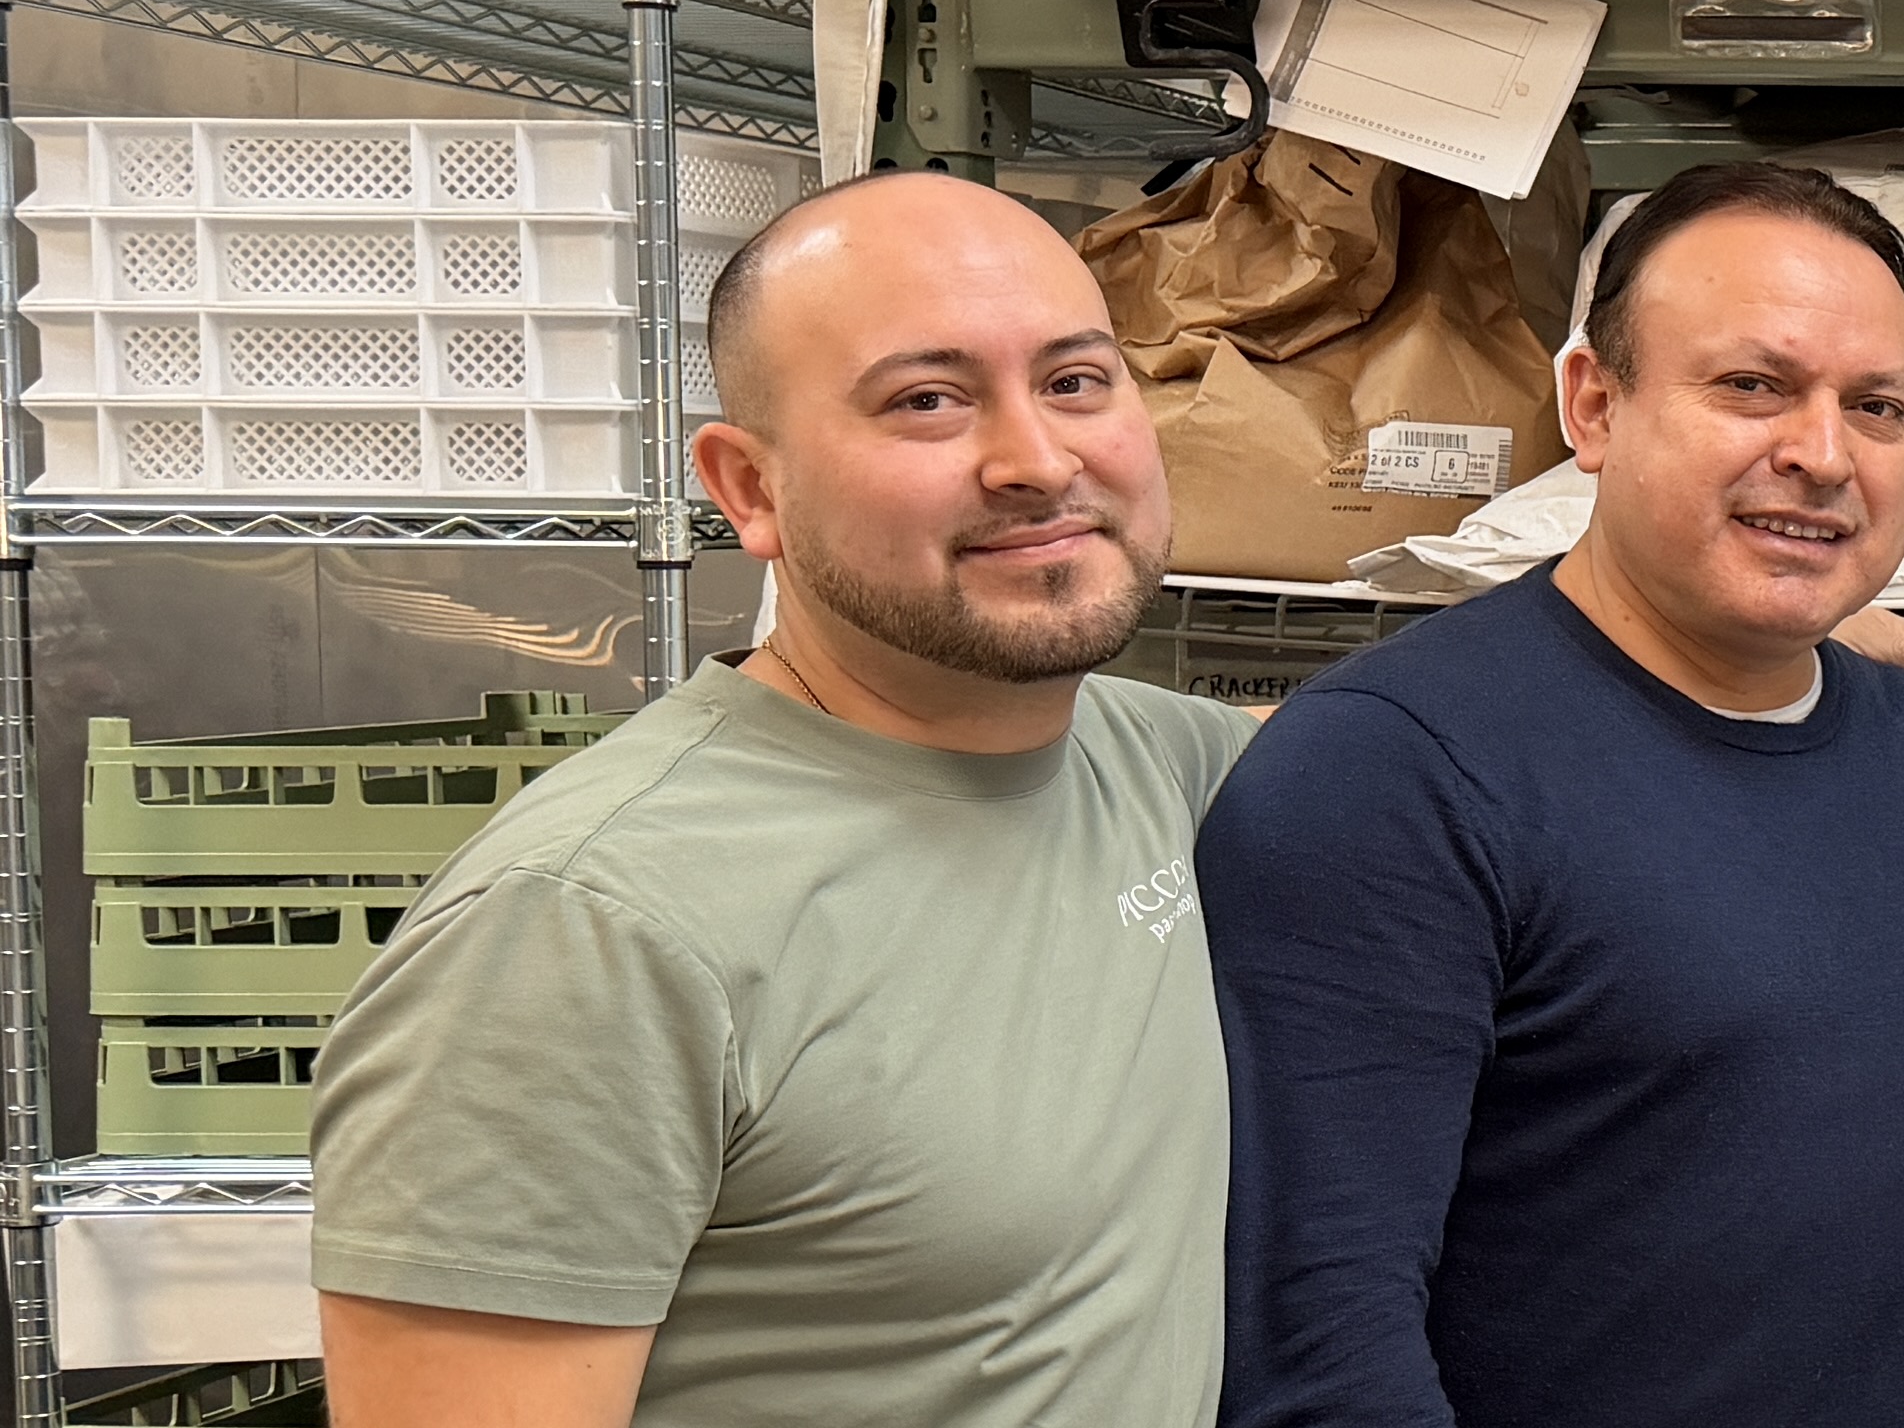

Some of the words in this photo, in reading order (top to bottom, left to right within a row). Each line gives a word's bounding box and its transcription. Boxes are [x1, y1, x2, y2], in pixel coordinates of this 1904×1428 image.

[1371, 454, 1377, 465] 2
[1394, 456, 1401, 466] 2
[1405, 456, 1420, 468] CS
